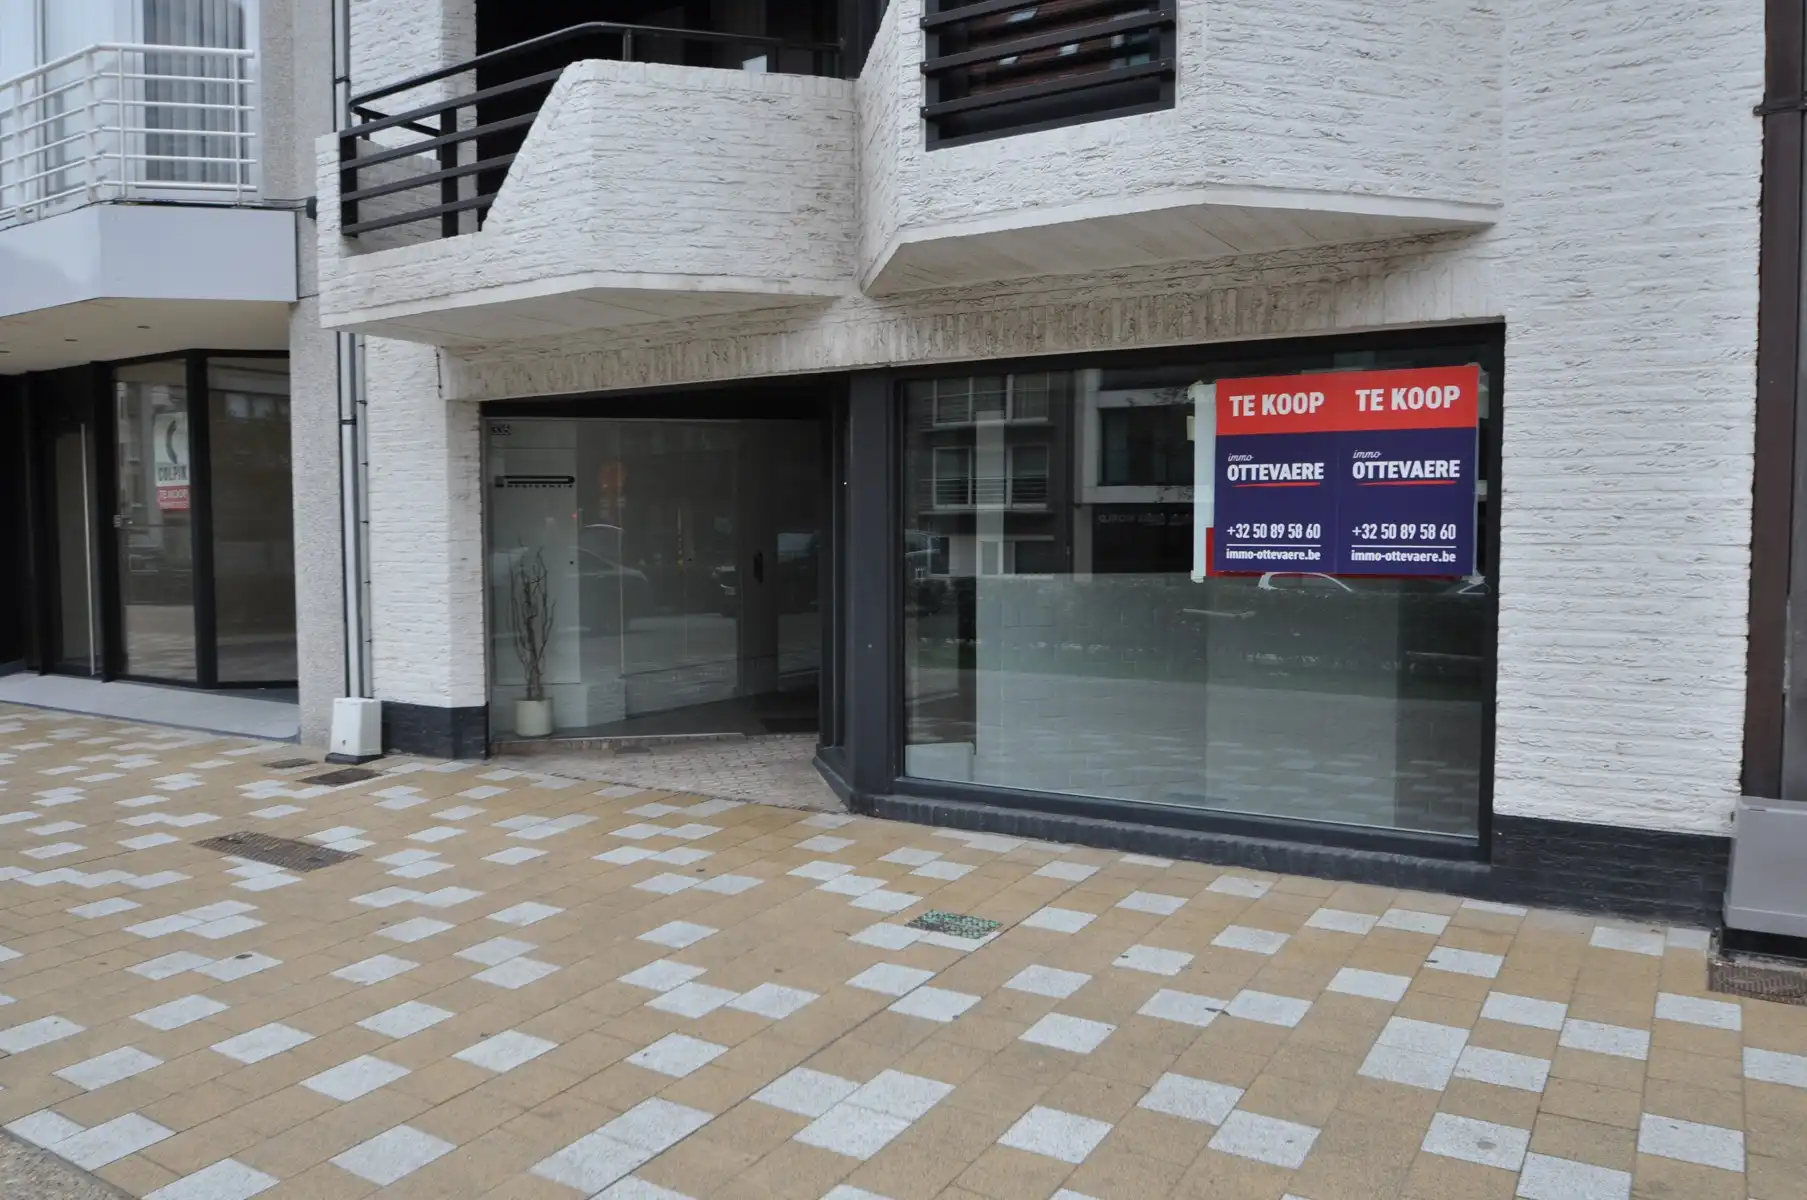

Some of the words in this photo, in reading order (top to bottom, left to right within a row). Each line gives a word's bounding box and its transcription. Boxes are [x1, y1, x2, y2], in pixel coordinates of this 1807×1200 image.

[1229, 394, 1256, 417] TE
[1261, 392, 1325, 416] KOOP
[1355, 388, 1384, 412] TE
[1391, 385, 1460, 411] KOOP
[1227, 453, 1255, 462] immo
[1352, 449, 1382, 459] immo
[1227, 462, 1325, 481] OTTEVAERE
[1352, 460, 1461, 479] OTTEVAERE
[1226, 523, 1250, 539] +32
[1252, 523, 1267, 539] 50
[1270, 523, 1285, 539] 89
[1288, 523, 1303, 539] 58
[1305, 523, 1321, 539] 60
[1352, 523, 1378, 540] +32
[1380, 523, 1397, 540] 50
[1400, 523, 1416, 540] 89
[1420, 523, 1436, 540] 58
[1440, 523, 1457, 540] 60
[1226, 548, 1321, 560] immo-ottevaere.be
[1351, 549, 1457, 562] immo-ottevaere.be
